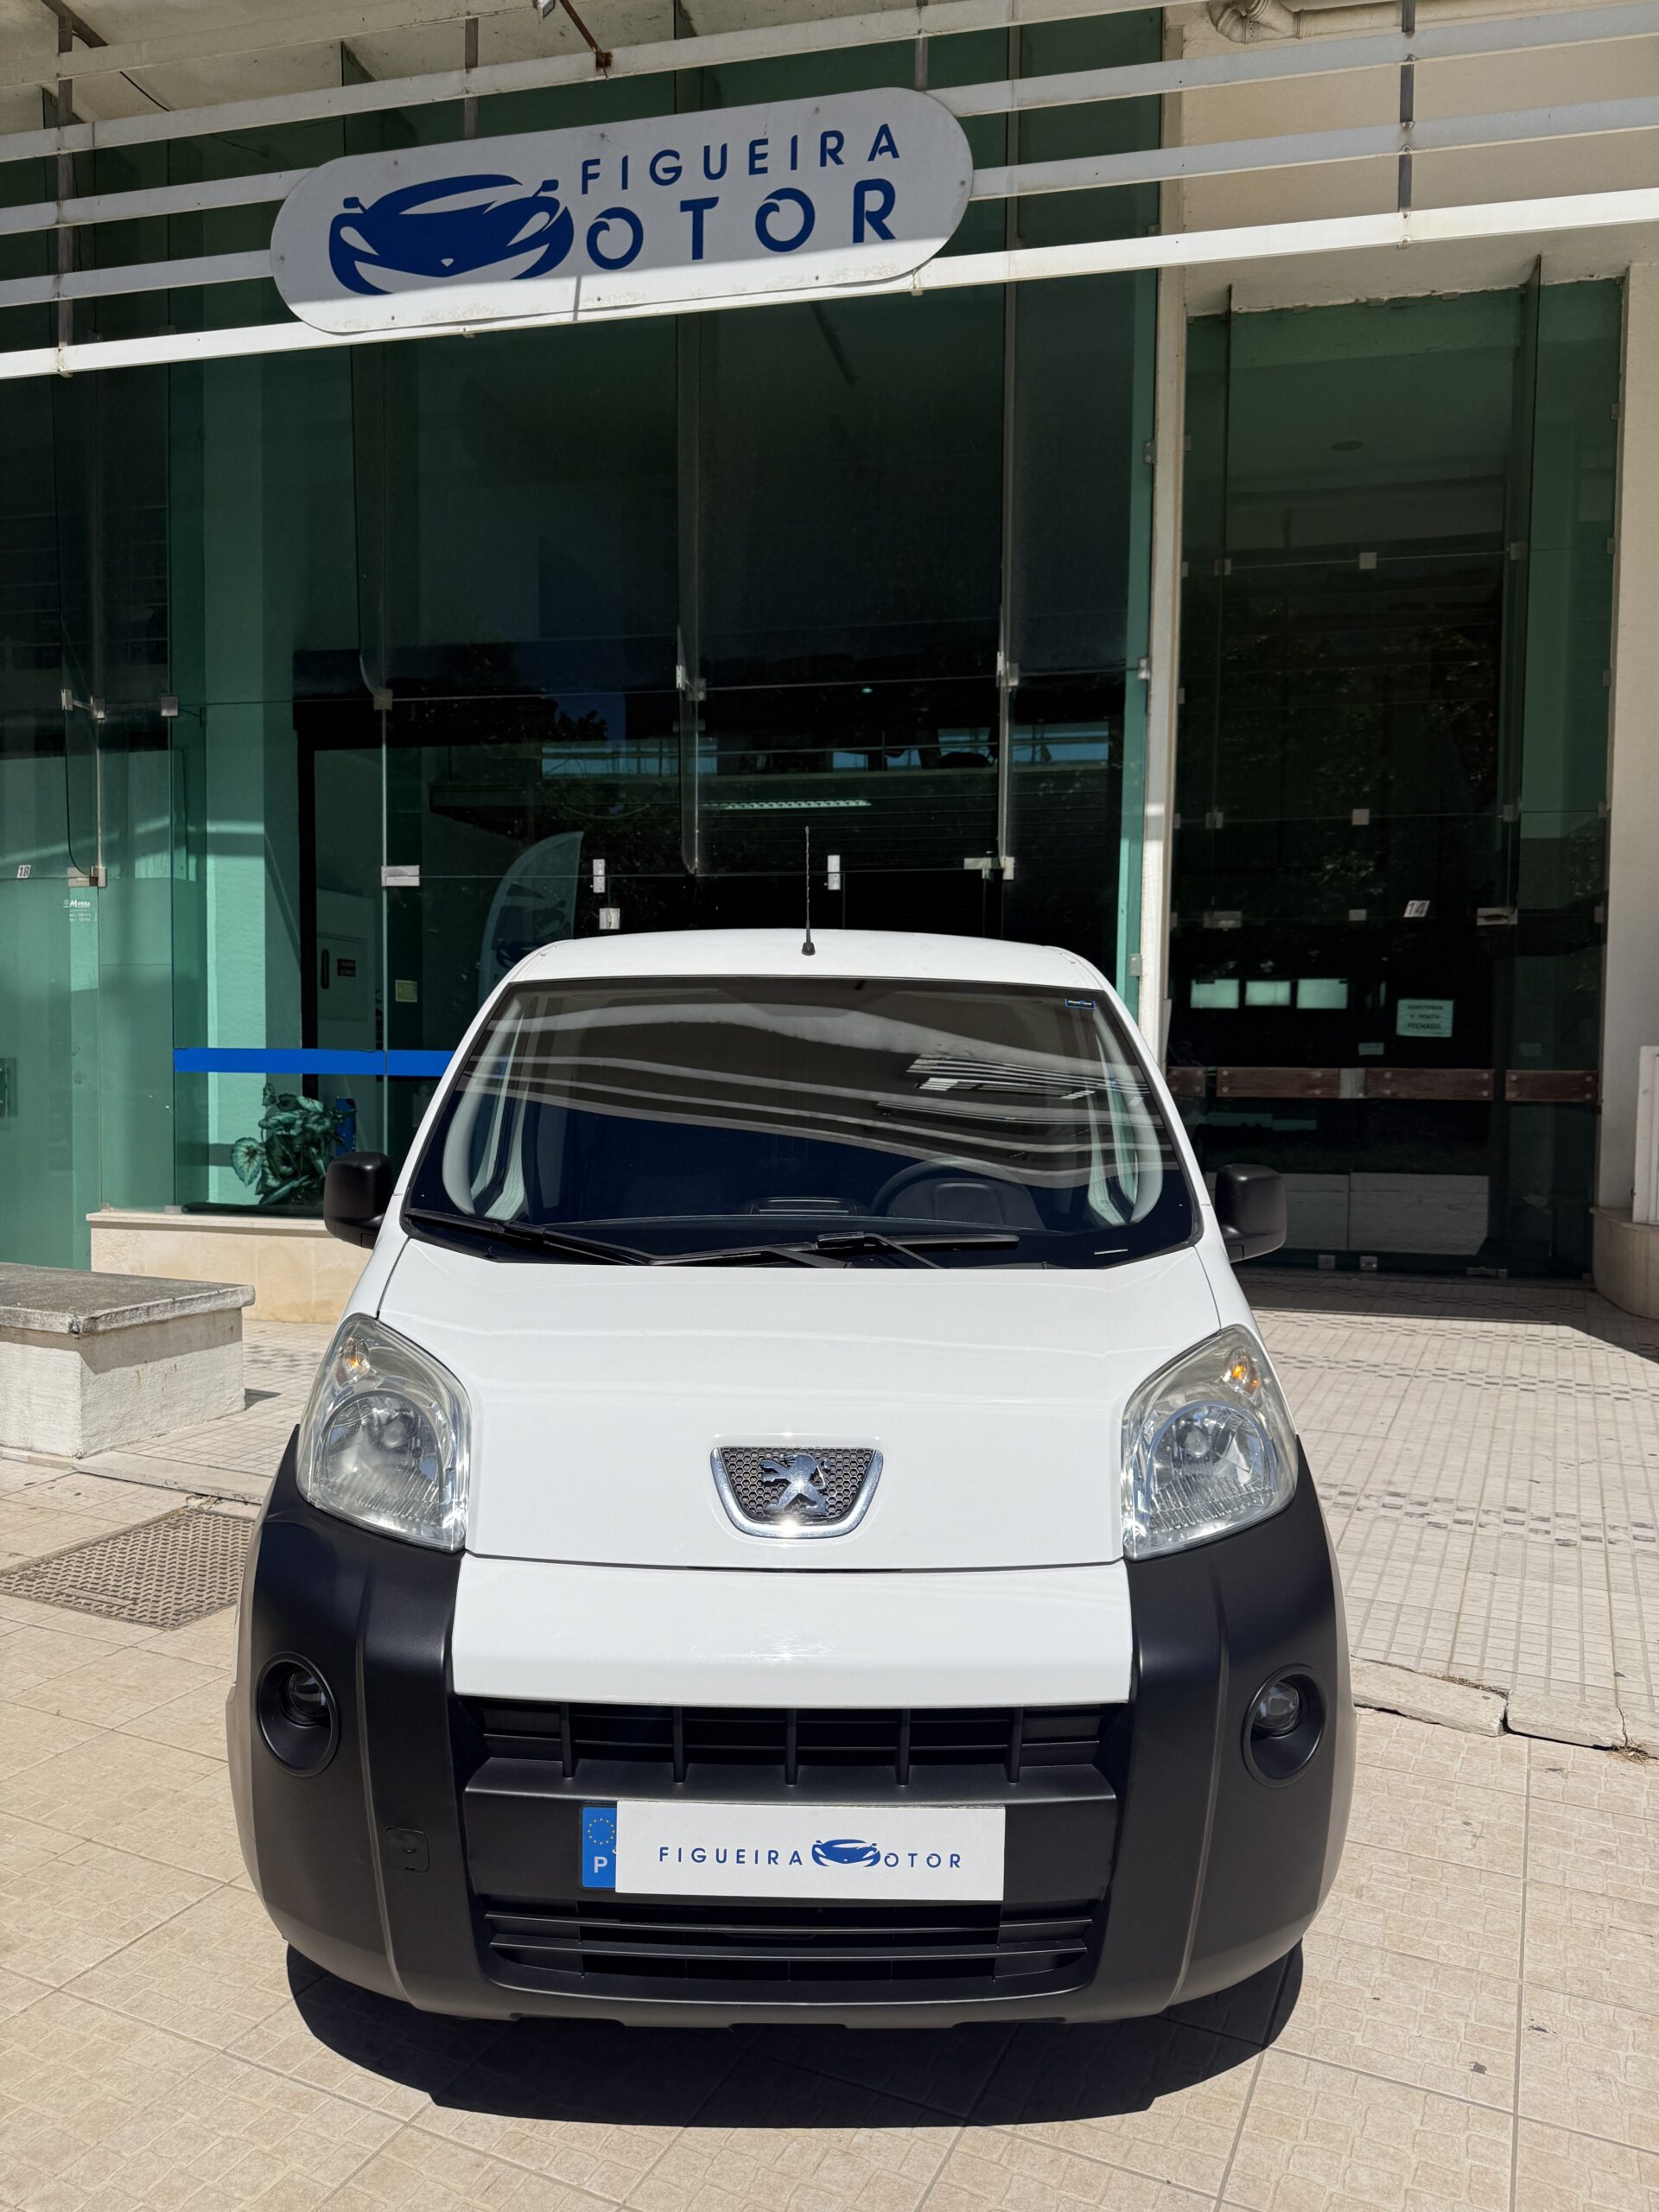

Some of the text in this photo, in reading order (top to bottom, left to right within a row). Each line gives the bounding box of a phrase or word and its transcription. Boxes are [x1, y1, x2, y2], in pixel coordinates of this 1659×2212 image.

[582, 124, 899, 194] FIGUEIRA
[18, 865, 30, 877] 18
[1407, 901, 1427, 916] 14
[594, 1856, 608, 1873] P
[658, 1846, 803, 1866] FIGUEIRA
